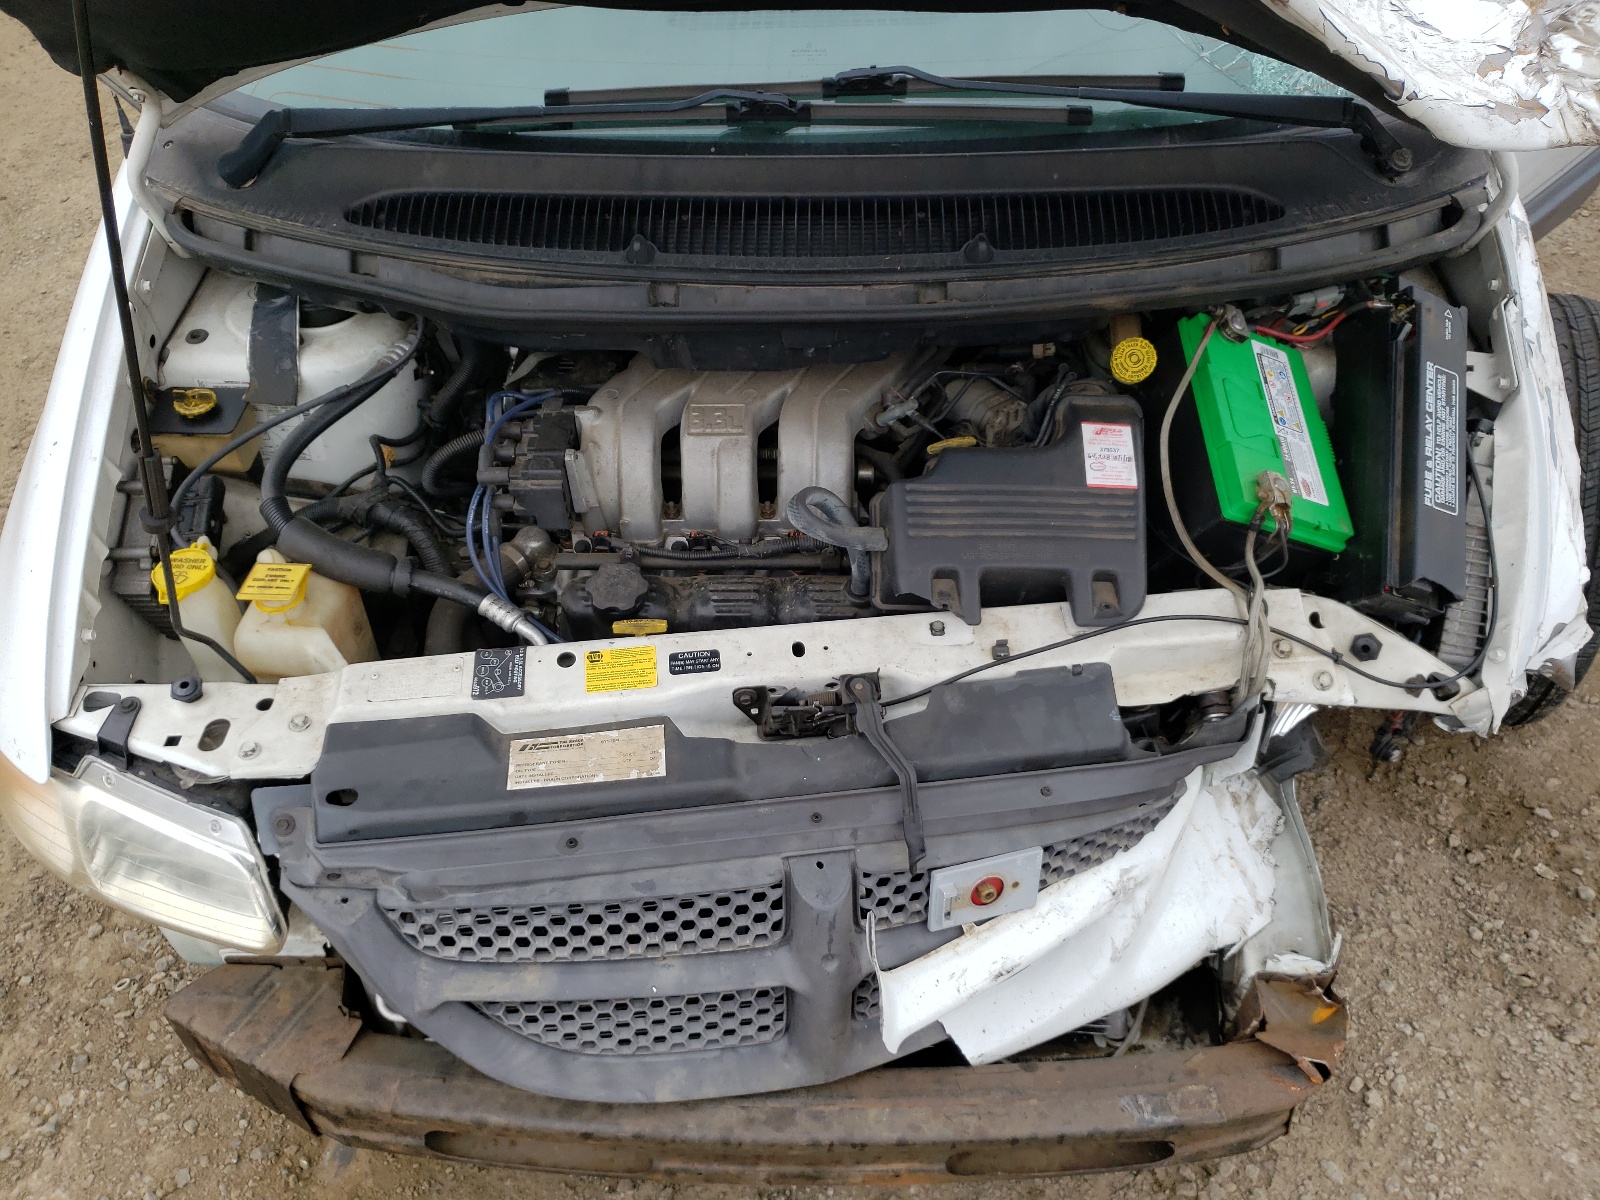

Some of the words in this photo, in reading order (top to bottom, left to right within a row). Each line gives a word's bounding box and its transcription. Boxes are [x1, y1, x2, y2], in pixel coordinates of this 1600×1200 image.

[1425, 361, 1434, 413] CENTER
[1425, 414, 1433, 457] RELAY
[1426, 460, 1432, 469] &
[1424, 470, 1432, 507] FUSE
[678, 651, 711, 659] CAUTION
